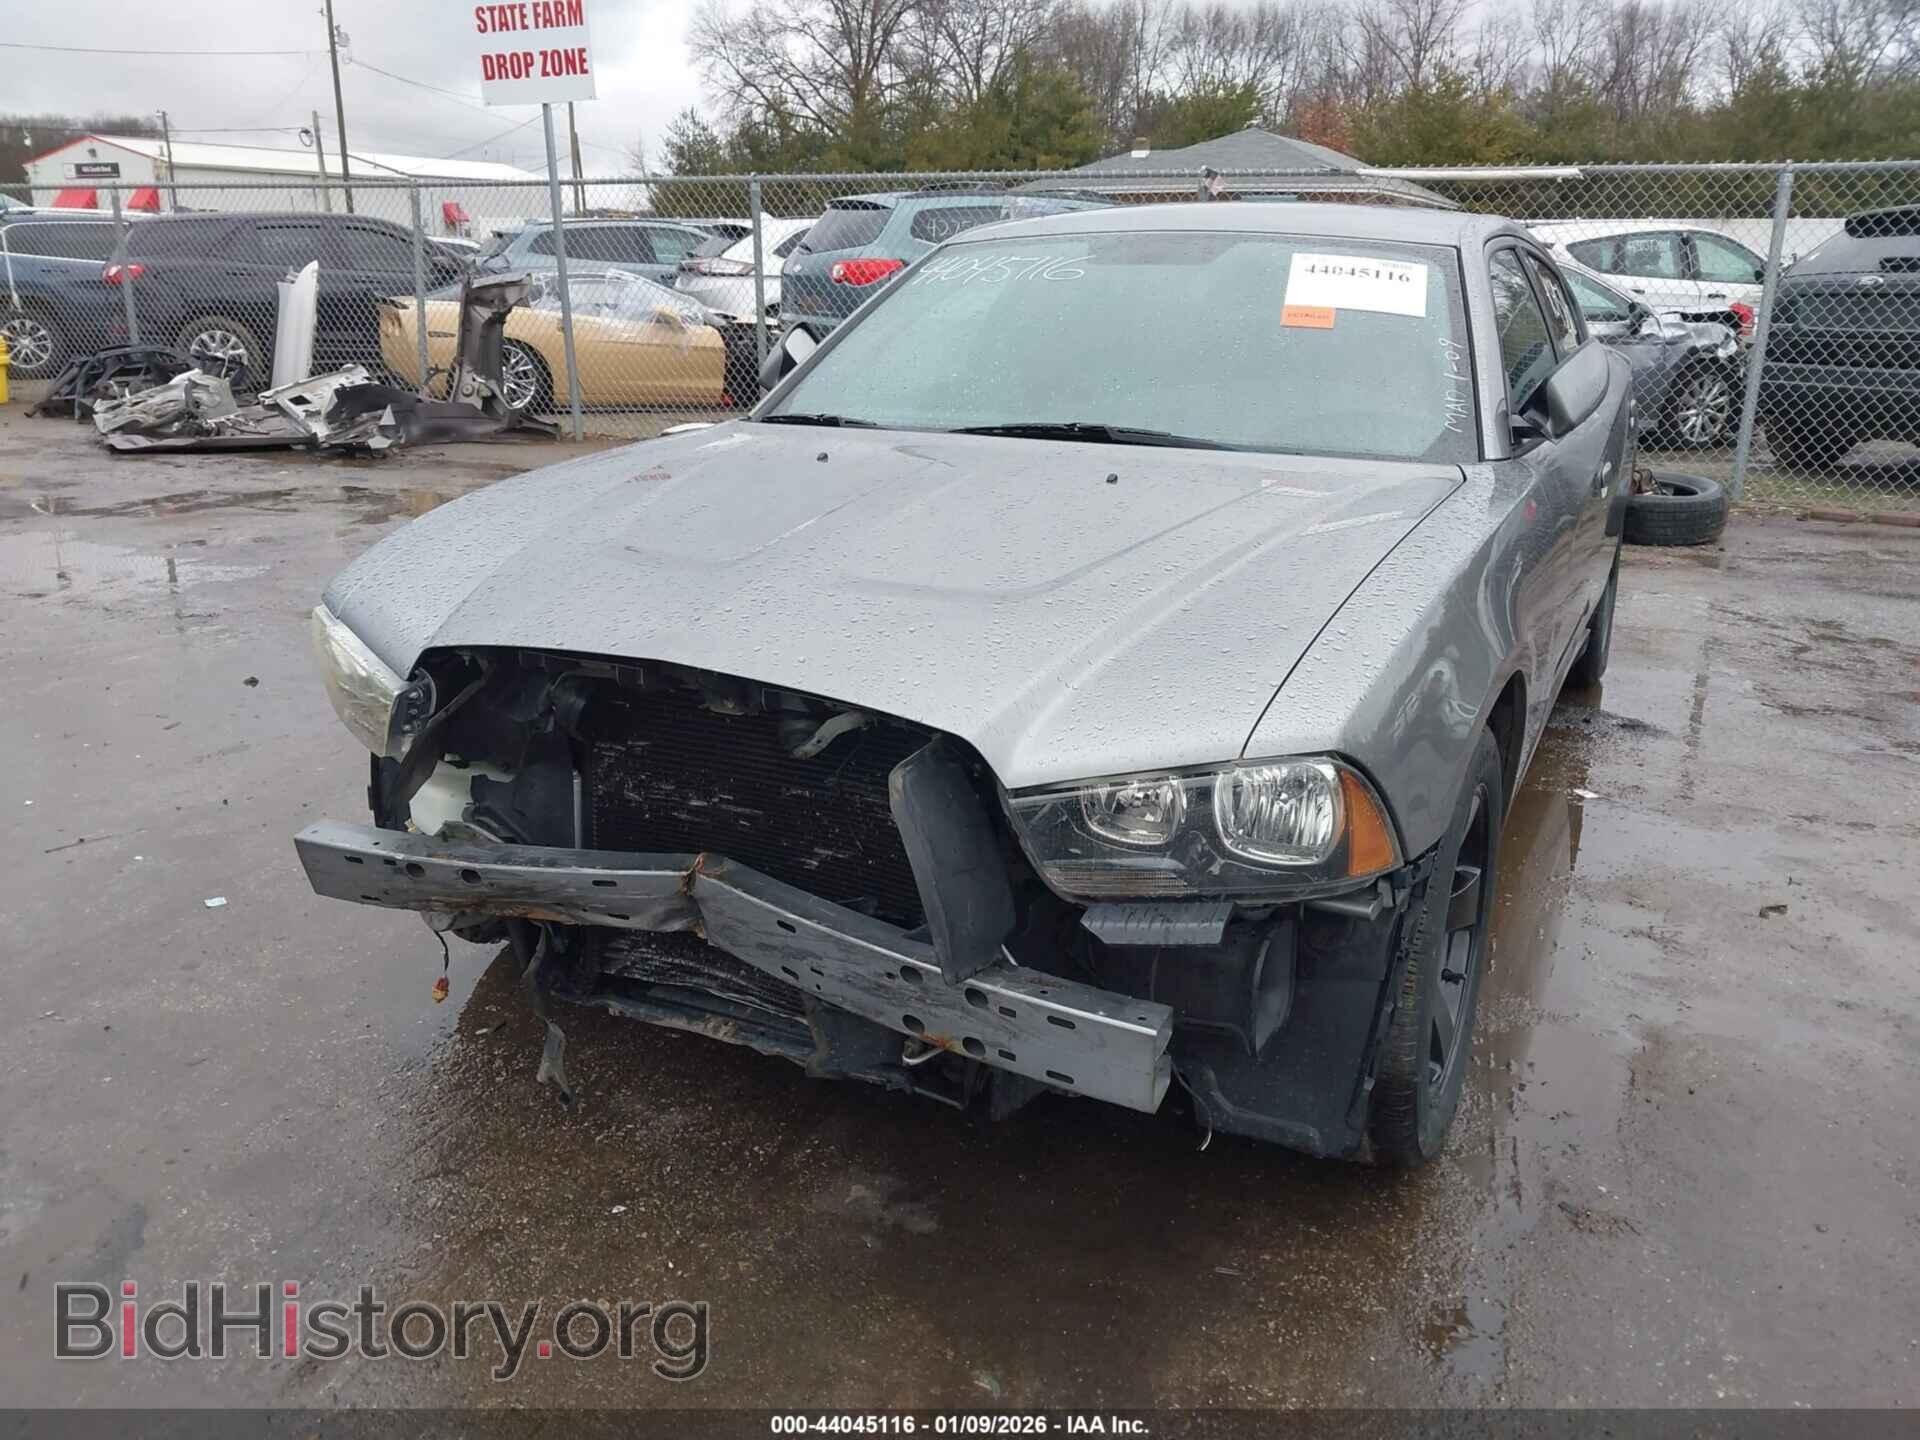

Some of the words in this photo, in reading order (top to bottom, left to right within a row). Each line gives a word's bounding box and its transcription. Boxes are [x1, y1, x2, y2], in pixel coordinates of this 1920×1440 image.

[475, 3, 529, 34] STATE
[532, 0, 584, 29] FARM
[481, 51, 535, 81] DROP
[539, 47, 589, 77] ZONE
[1304, 263, 1411, 283] 44045116
